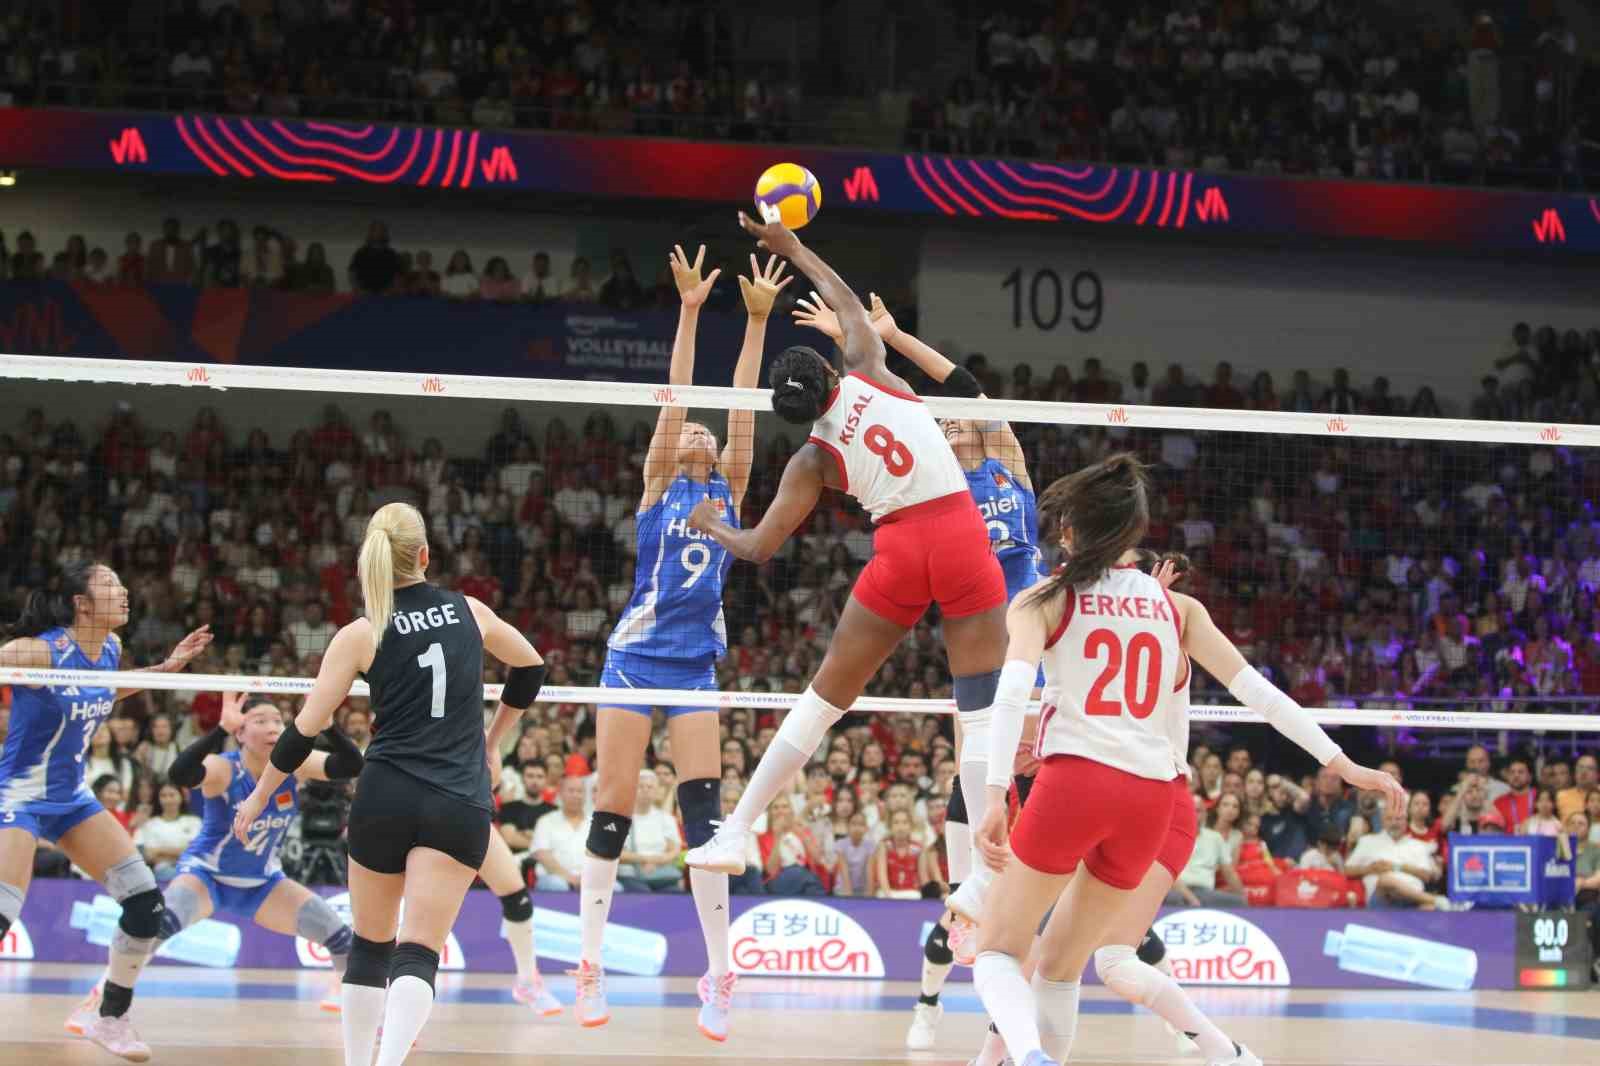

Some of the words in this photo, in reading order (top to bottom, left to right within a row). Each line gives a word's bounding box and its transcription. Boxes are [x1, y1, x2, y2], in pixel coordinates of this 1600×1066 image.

[1001, 267, 1103, 331] 109
[566, 337, 672, 353] VOLLEYBAL
[421, 377, 445, 393] VNL
[839, 394, 874, 446] KISAL
[1106, 408, 1129, 424] VNL
[1326, 416, 1348, 433] VNL
[863, 424, 914, 477] 8
[977, 494, 1019, 520] aier
[681, 543, 711, 589] 9
[392, 604, 460, 635] ÖRGE
[1079, 594, 1169, 622] ERKEK
[267, 680, 314, 689] VOLLEYBA
[417, 643, 447, 718] 1
[1084, 628, 1162, 720] 20
[248, 814, 292, 833] aier
[752, 912, 841, 937] 百岁山
[1163, 922, 1248, 946] 百岁山
[1534, 918, 1569, 946] 90.0
[1170, 948, 1276, 981] anten
